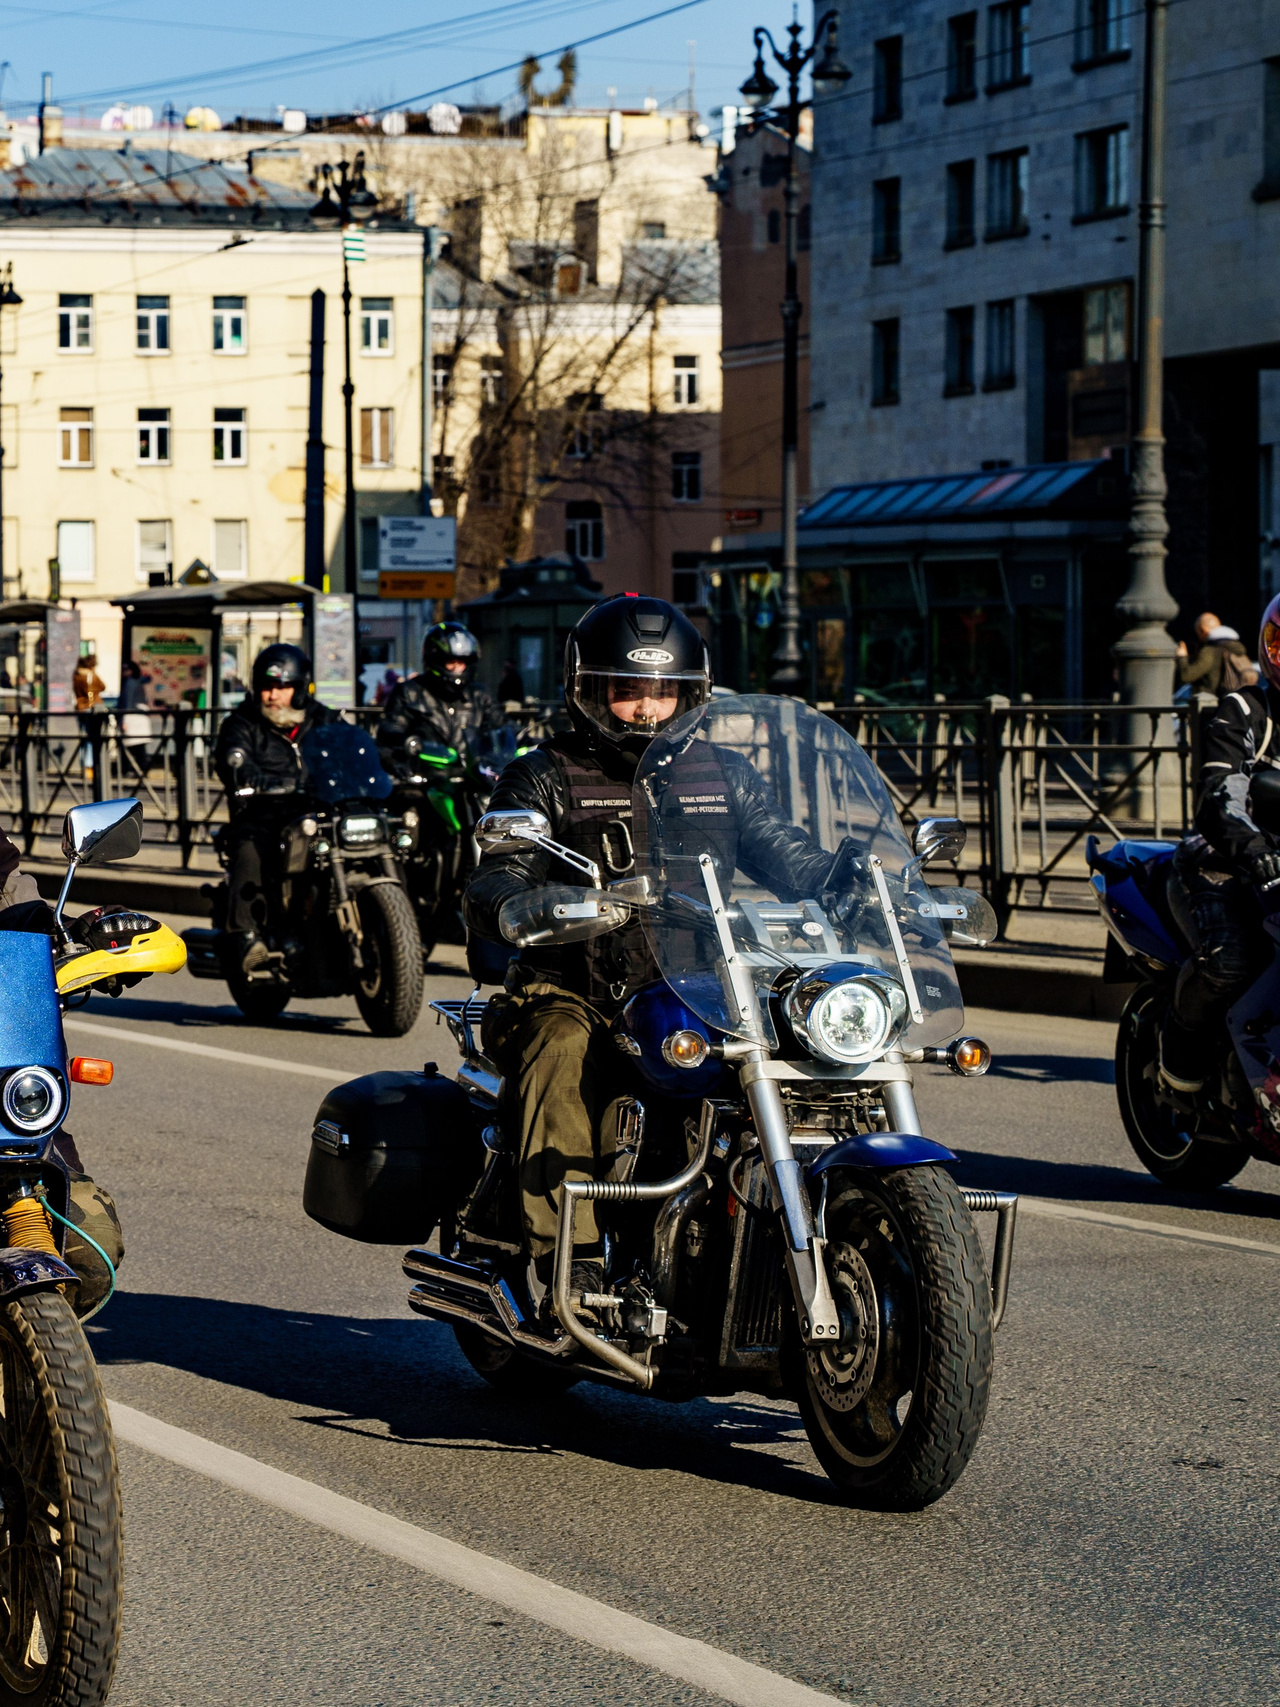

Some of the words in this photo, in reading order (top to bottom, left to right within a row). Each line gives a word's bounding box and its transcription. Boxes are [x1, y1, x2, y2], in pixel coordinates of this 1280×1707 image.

[632, 650, 669, 661] HJC
[580, 799, 603, 807] CHAPTER
[603, 799, 631, 807] PRESIDENT
[682, 806, 729, 814] SAINT-PETERSBURG
